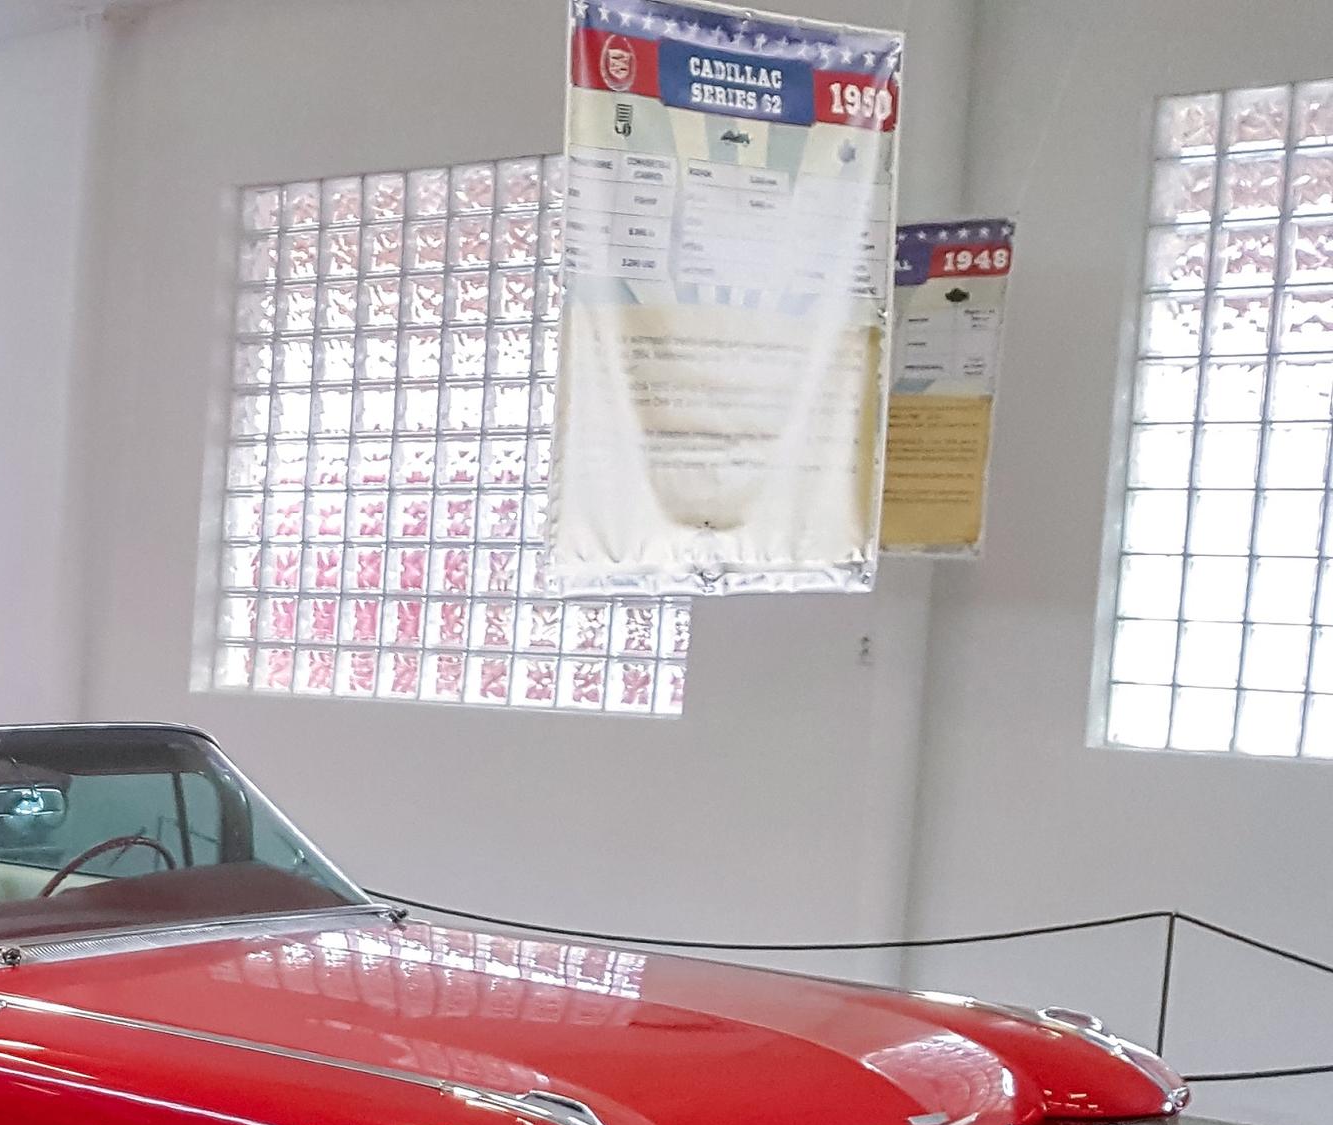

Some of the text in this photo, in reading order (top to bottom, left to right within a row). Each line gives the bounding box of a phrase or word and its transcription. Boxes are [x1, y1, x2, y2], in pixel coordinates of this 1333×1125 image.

[689, 57, 783, 90] CADILLAC
[690, 82, 757, 110] SERIES
[943, 248, 1010, 272] 1948
